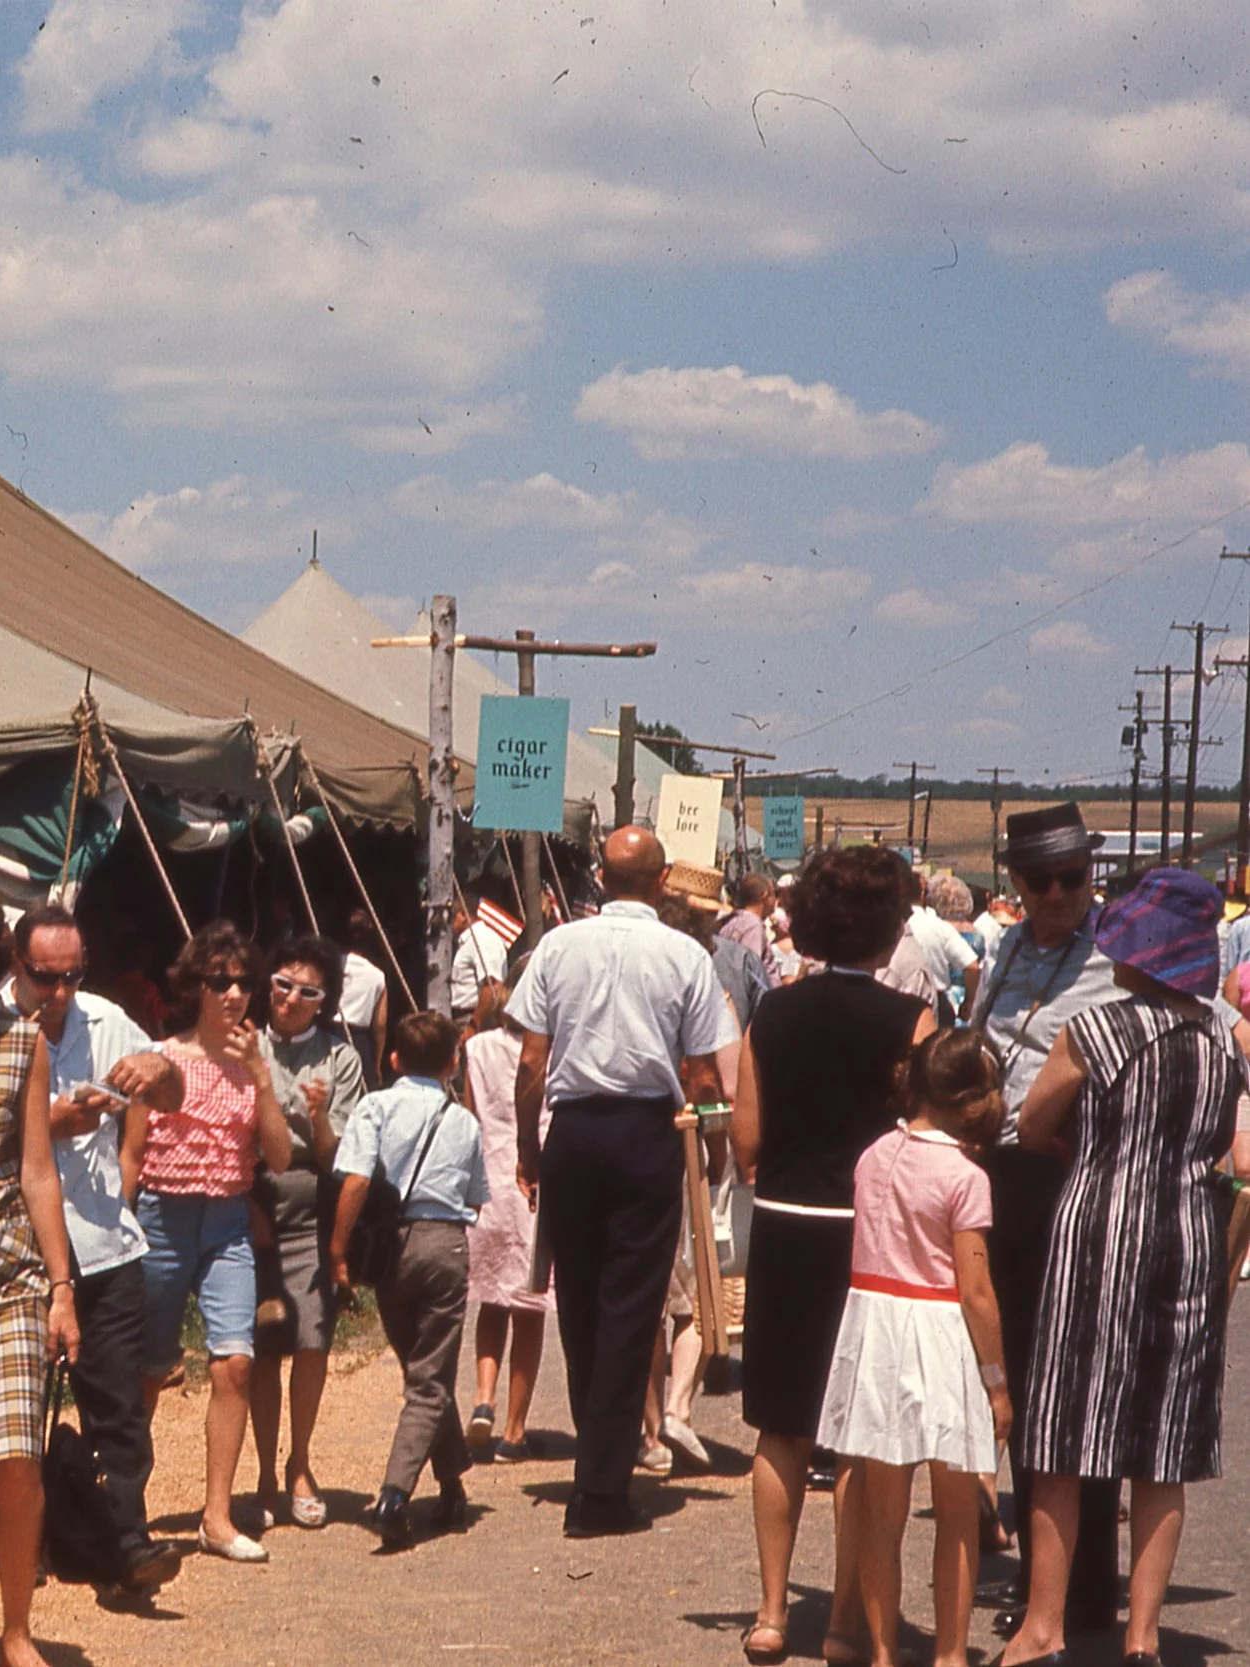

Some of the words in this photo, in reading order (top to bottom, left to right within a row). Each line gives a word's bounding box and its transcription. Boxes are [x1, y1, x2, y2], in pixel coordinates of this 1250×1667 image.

[497, 737, 548, 762] cigar
[492, 758, 552, 779] maker
[679, 801, 699, 816] bee
[676, 817, 699, 832] lore
[775, 816, 792, 826] and
[776, 839, 793, 849] lore
